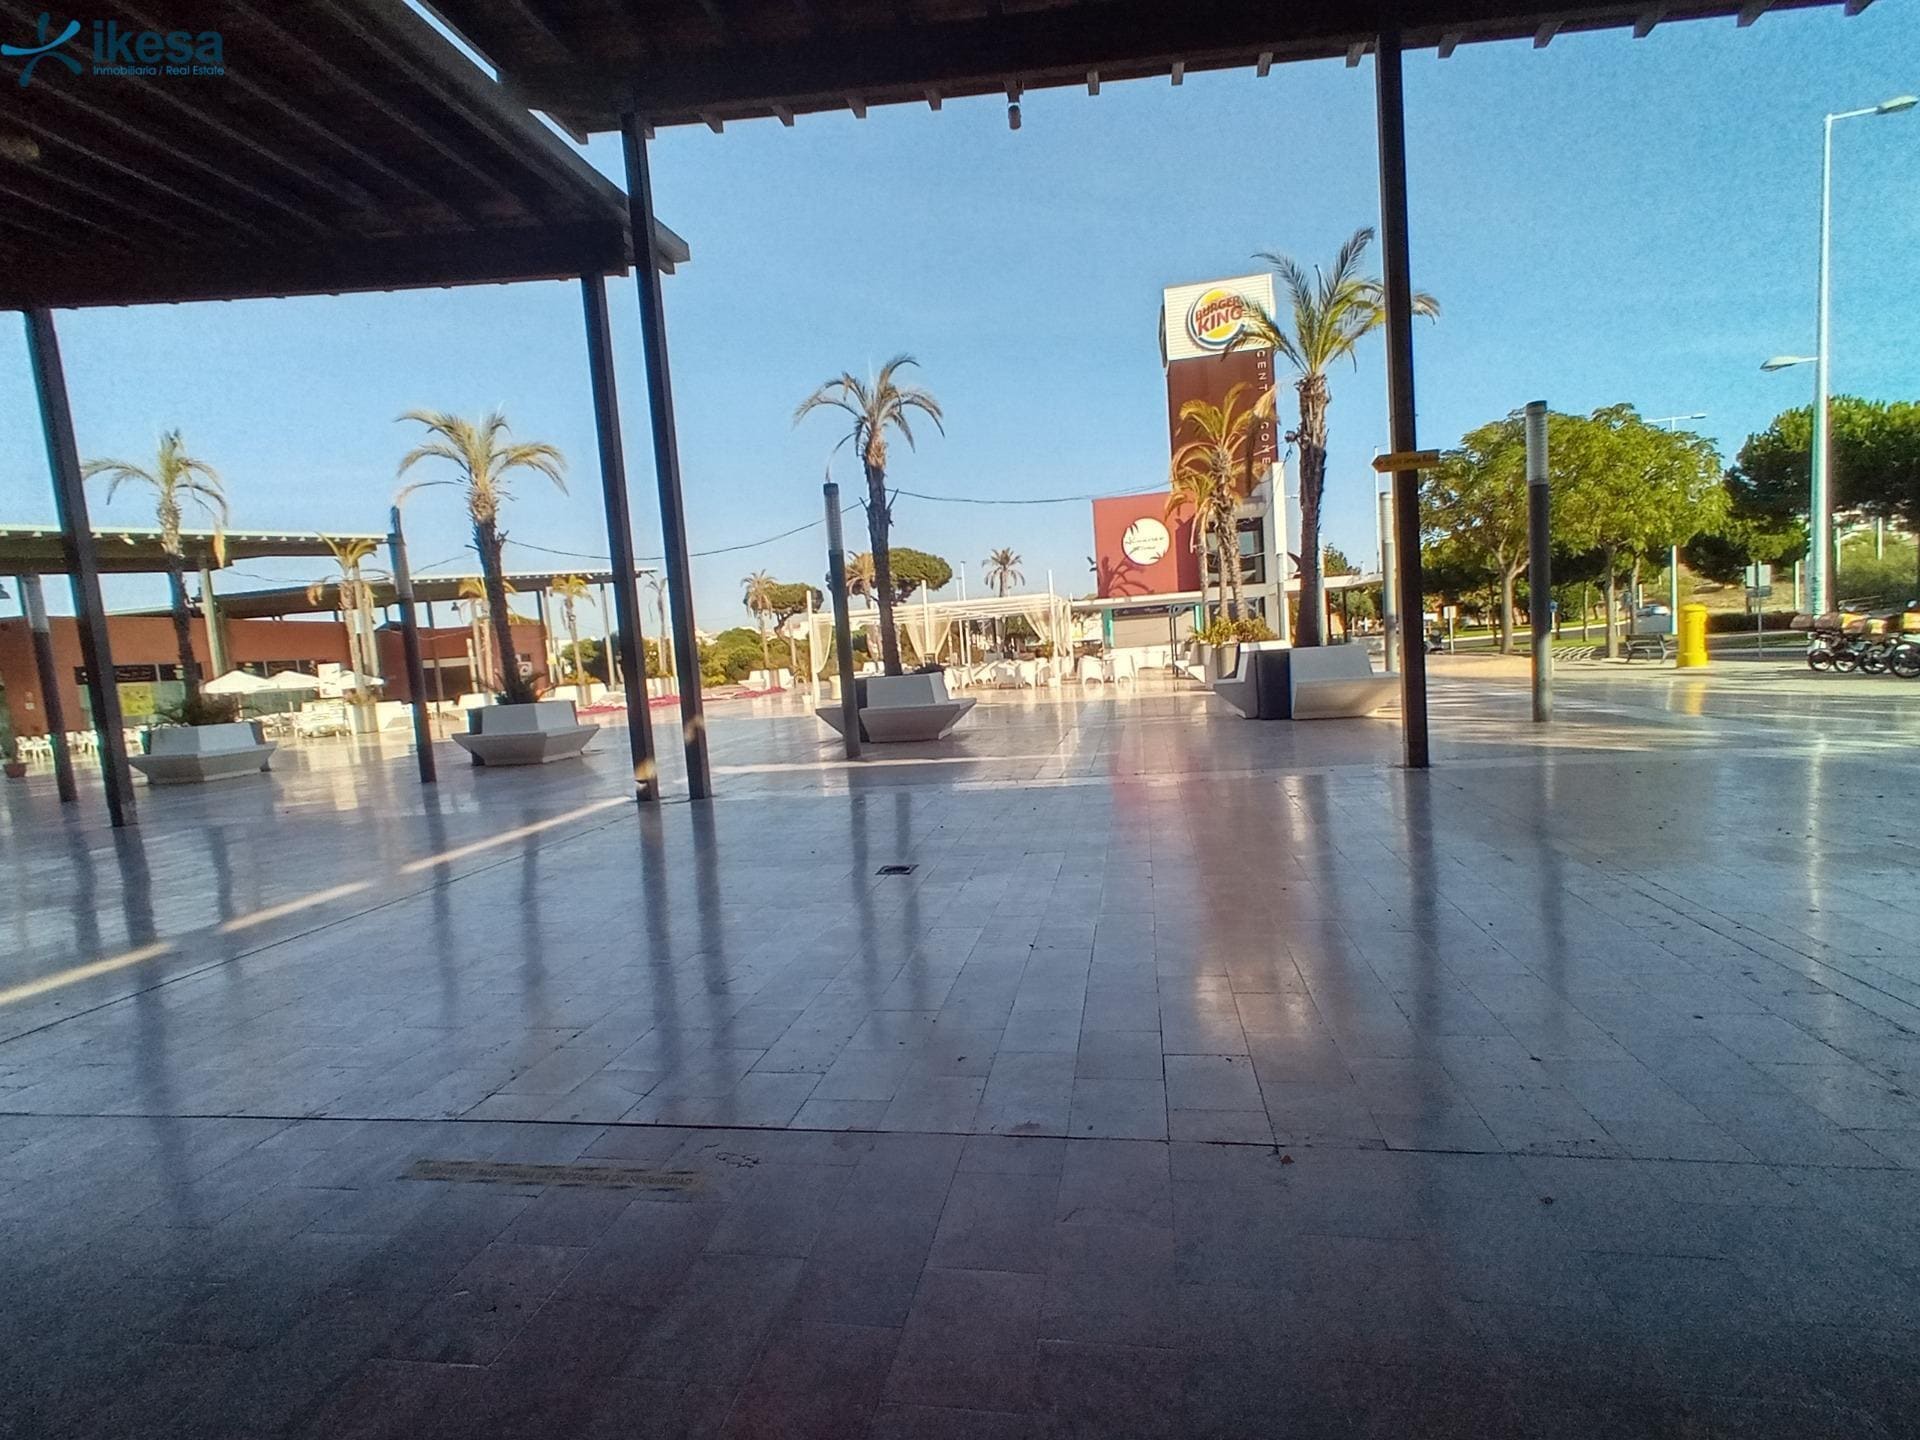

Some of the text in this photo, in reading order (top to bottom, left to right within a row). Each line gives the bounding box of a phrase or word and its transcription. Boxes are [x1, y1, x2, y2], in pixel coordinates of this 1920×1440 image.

[1196, 295, 1244, 322] BURGER
[1198, 305, 1243, 336] KING
[1260, 421, 1271, 464] COME
